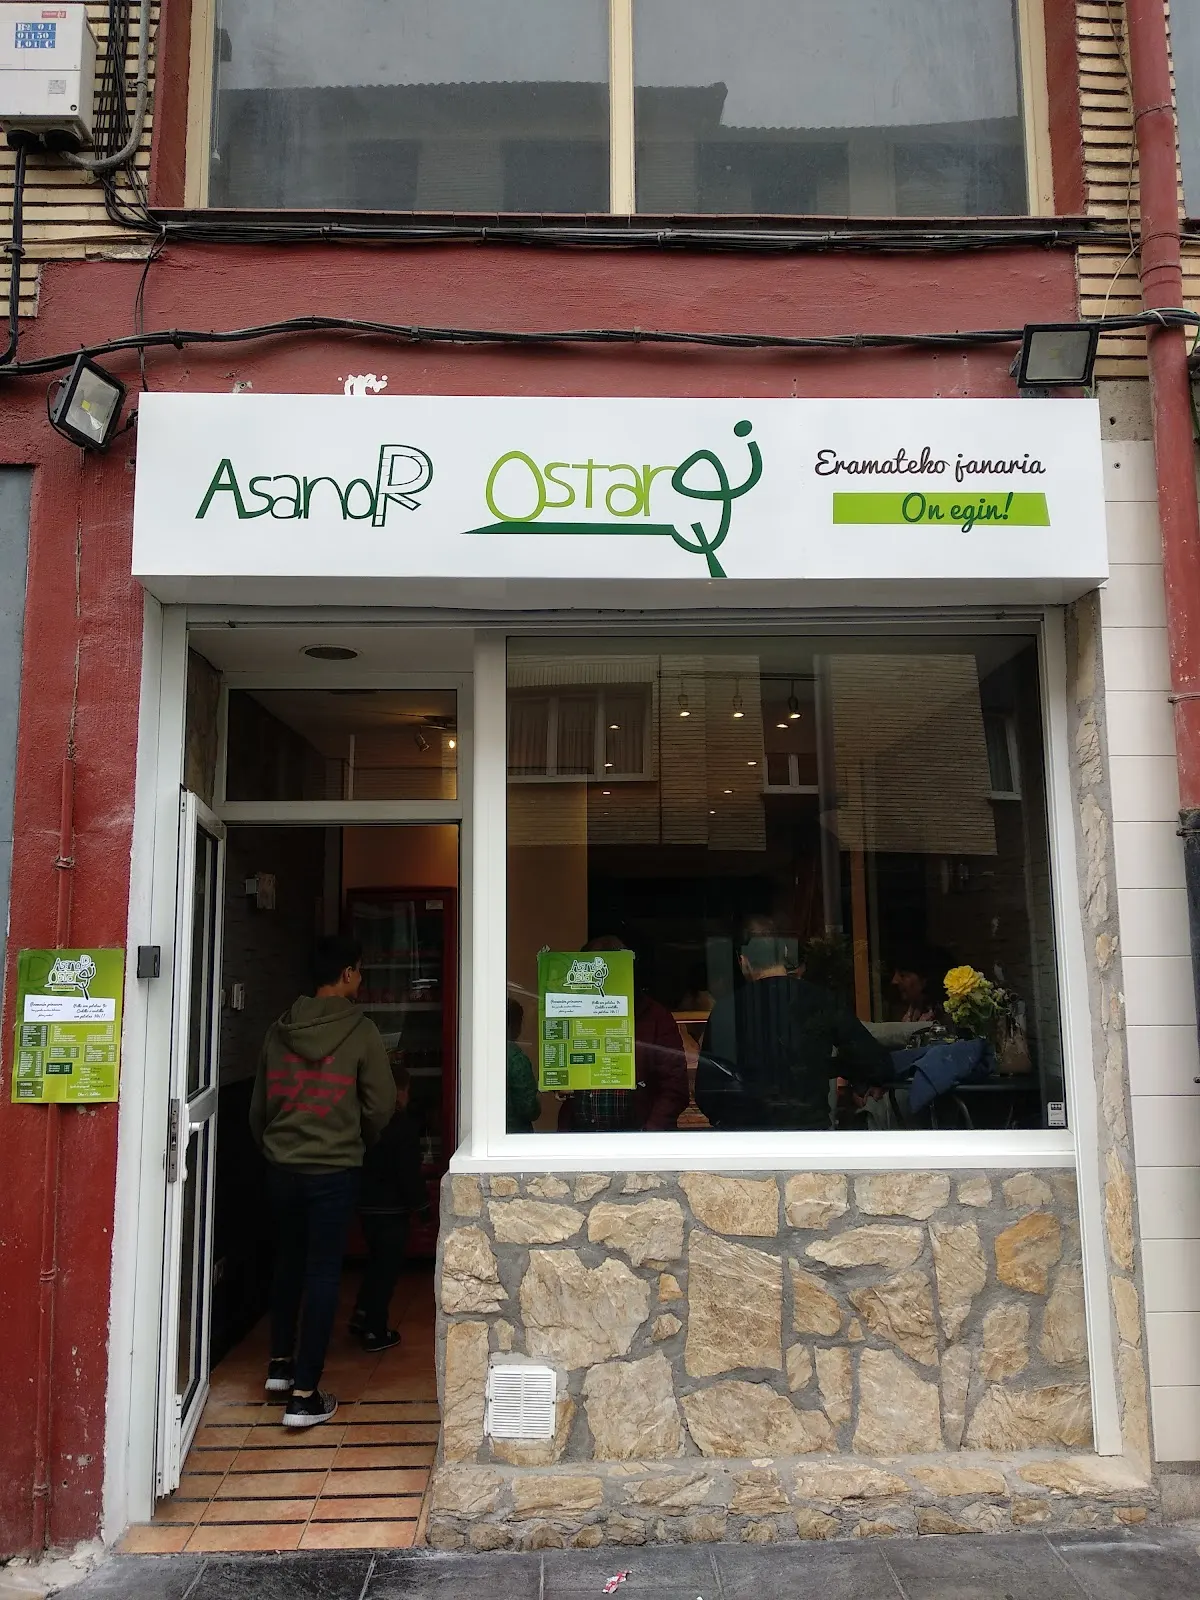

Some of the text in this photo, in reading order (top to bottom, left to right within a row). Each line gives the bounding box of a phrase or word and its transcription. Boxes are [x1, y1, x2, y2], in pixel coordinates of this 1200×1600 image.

[814, 446, 1047, 483] Eramateko janaria
[901, 491, 1014, 533] On egin!
